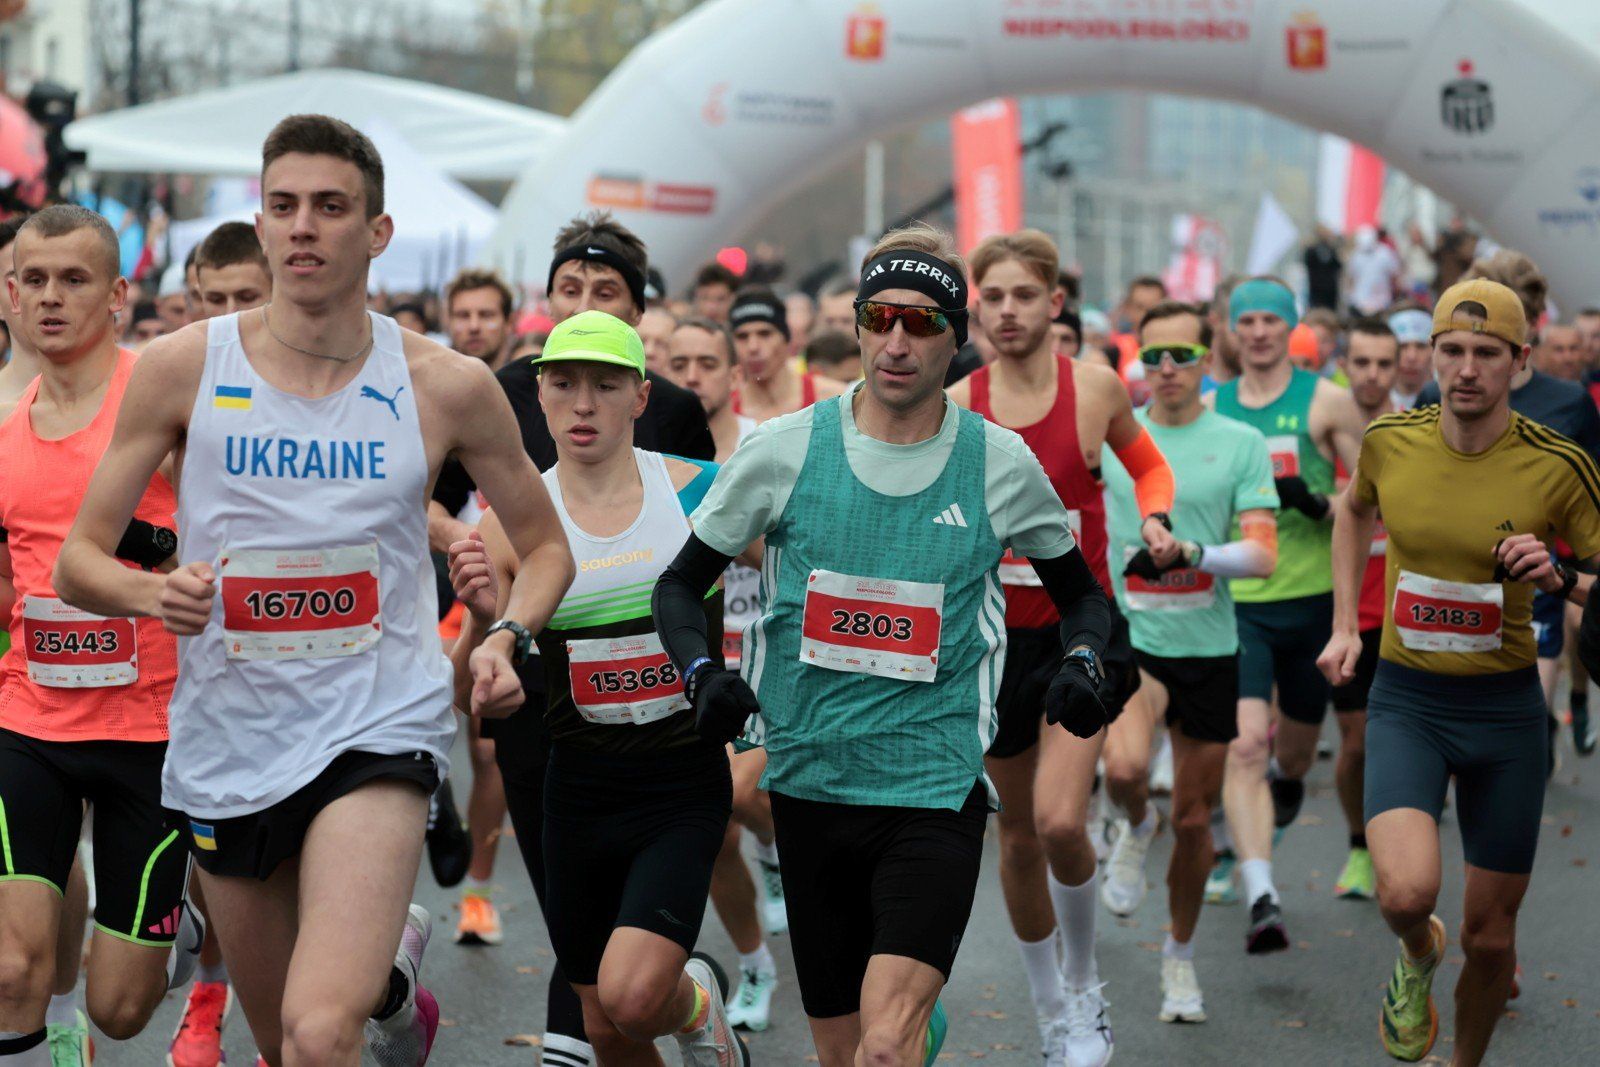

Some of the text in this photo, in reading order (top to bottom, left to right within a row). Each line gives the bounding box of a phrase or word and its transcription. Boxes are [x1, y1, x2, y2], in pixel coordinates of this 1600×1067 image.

[889, 259, 960, 298] TERREX
[226, 436, 386, 479] UKRAINE
[581, 548, 654, 572] saucony
[244, 587, 356, 619] 16700
[1410, 602, 1482, 628] 12183
[830, 609, 914, 642] 2803
[34, 629, 119, 655] 25443
[588, 661, 679, 694] 15368
